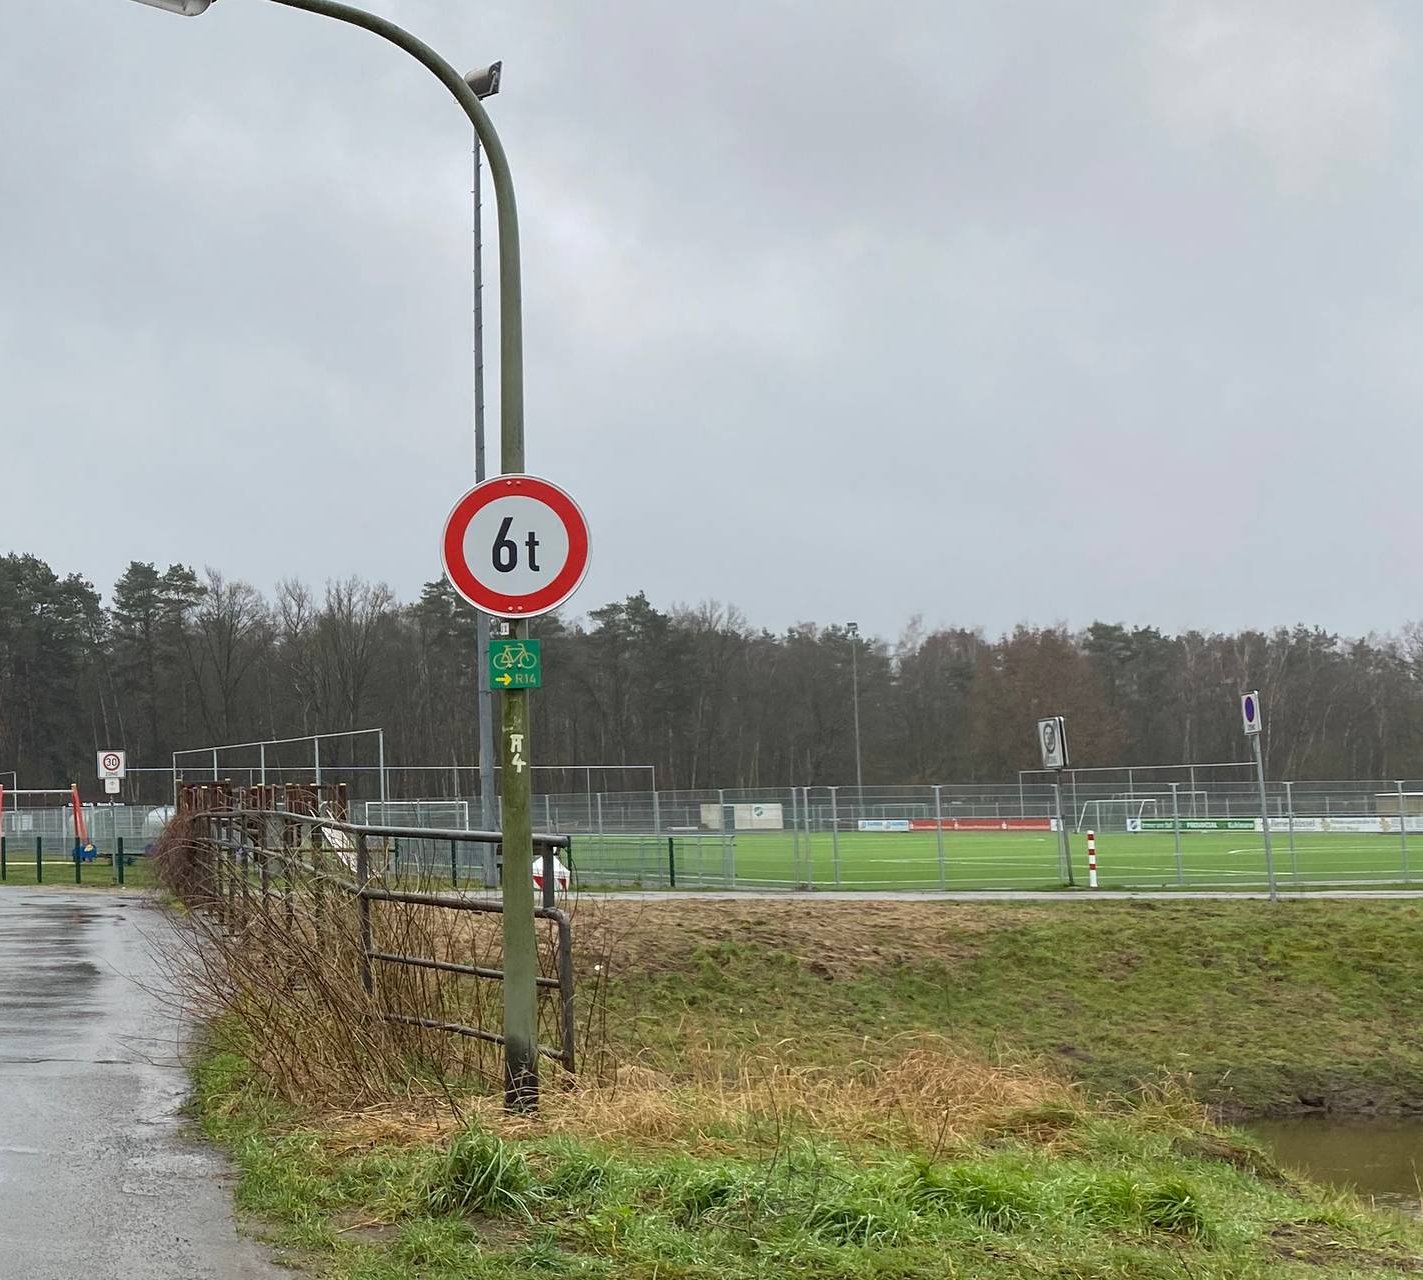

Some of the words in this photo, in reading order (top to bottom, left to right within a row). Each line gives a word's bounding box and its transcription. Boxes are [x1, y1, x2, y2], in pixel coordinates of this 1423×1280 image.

[491, 516, 540, 573] 6t
[514, 673, 537, 684] R14
[106, 758, 117, 766] 30
[511, 752, 527, 773] 4
